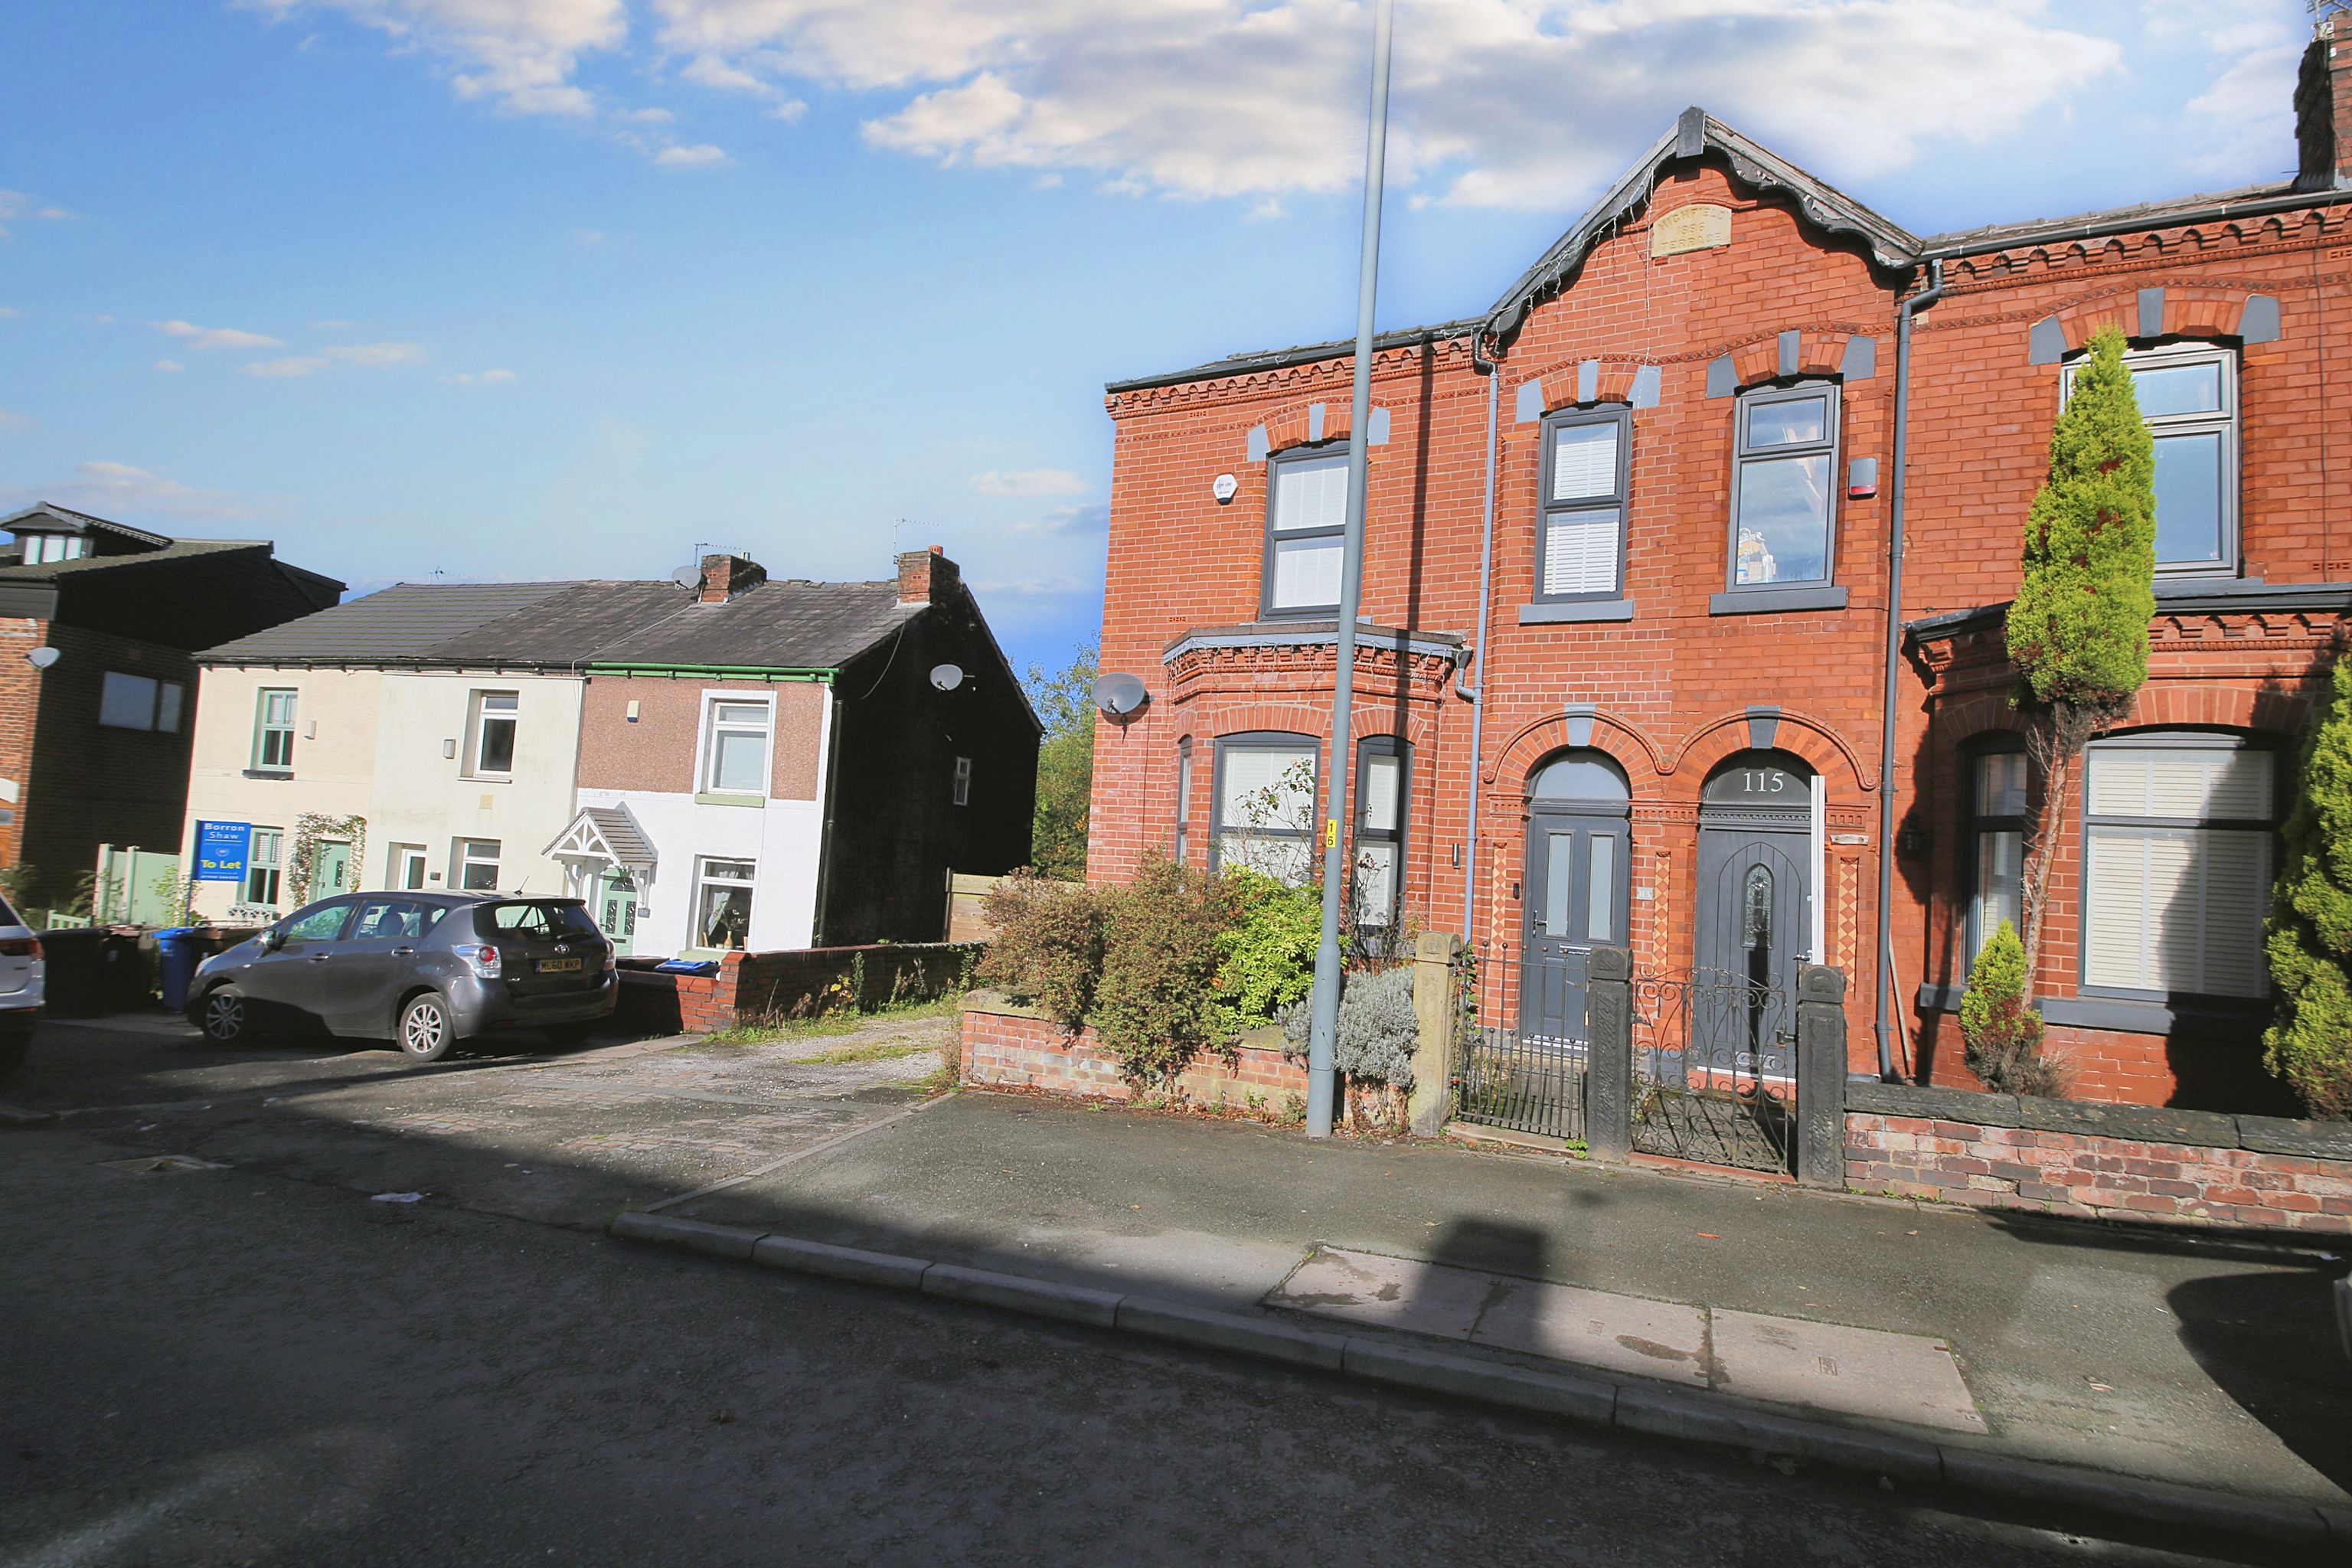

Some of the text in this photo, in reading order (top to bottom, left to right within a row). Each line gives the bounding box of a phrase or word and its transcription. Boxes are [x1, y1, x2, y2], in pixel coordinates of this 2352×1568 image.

[1658, 207, 1726, 230] HIGHFIELD
[1660, 232, 1722, 250] TERRACE
[1743, 772, 1784, 792] 115
[204, 823, 244, 831] Borron
[201, 859, 242, 870] To Let
